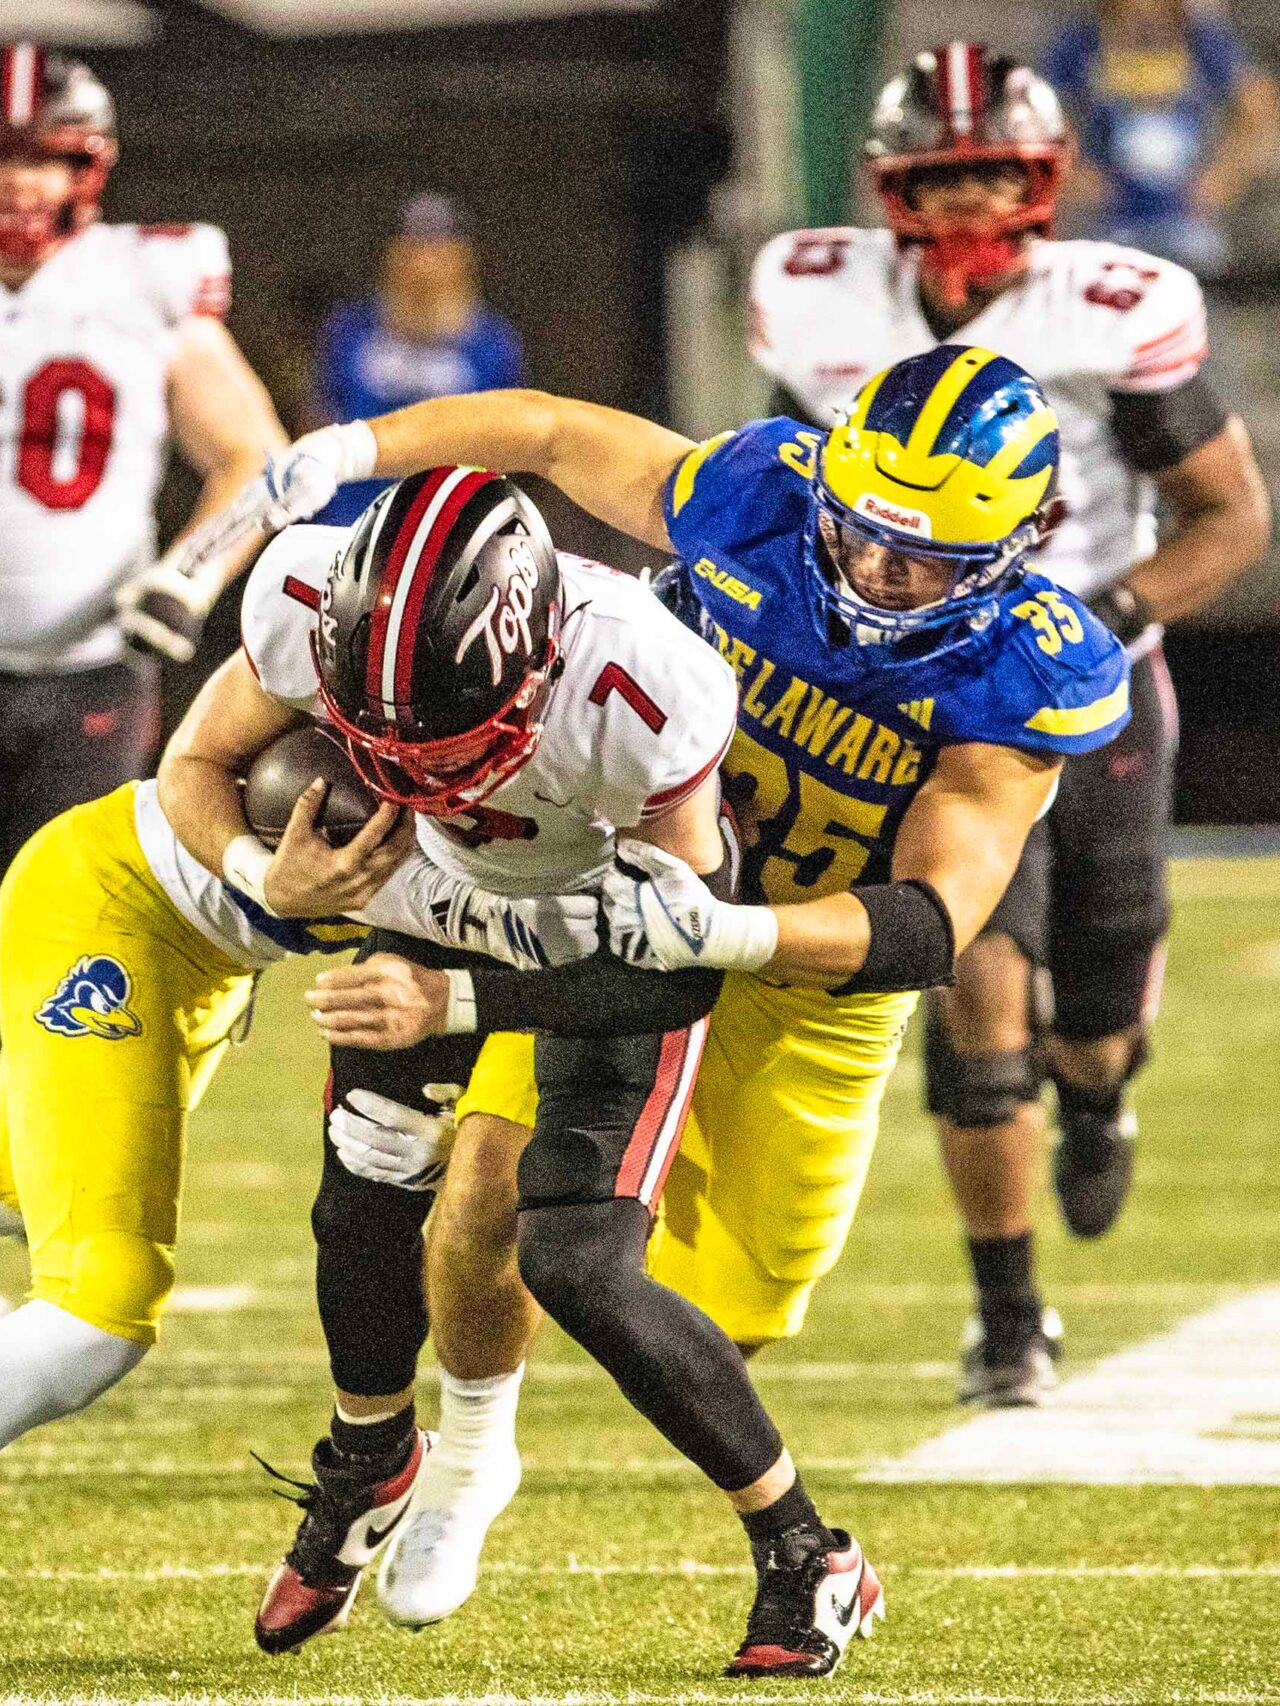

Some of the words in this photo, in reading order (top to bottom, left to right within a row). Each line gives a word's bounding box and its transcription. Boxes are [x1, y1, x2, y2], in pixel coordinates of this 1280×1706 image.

[865, 499, 921, 529] Riddell
[455, 541, 539, 686] Tops
[1010, 590, 1084, 656] 35
[588, 661, 669, 735] 7
